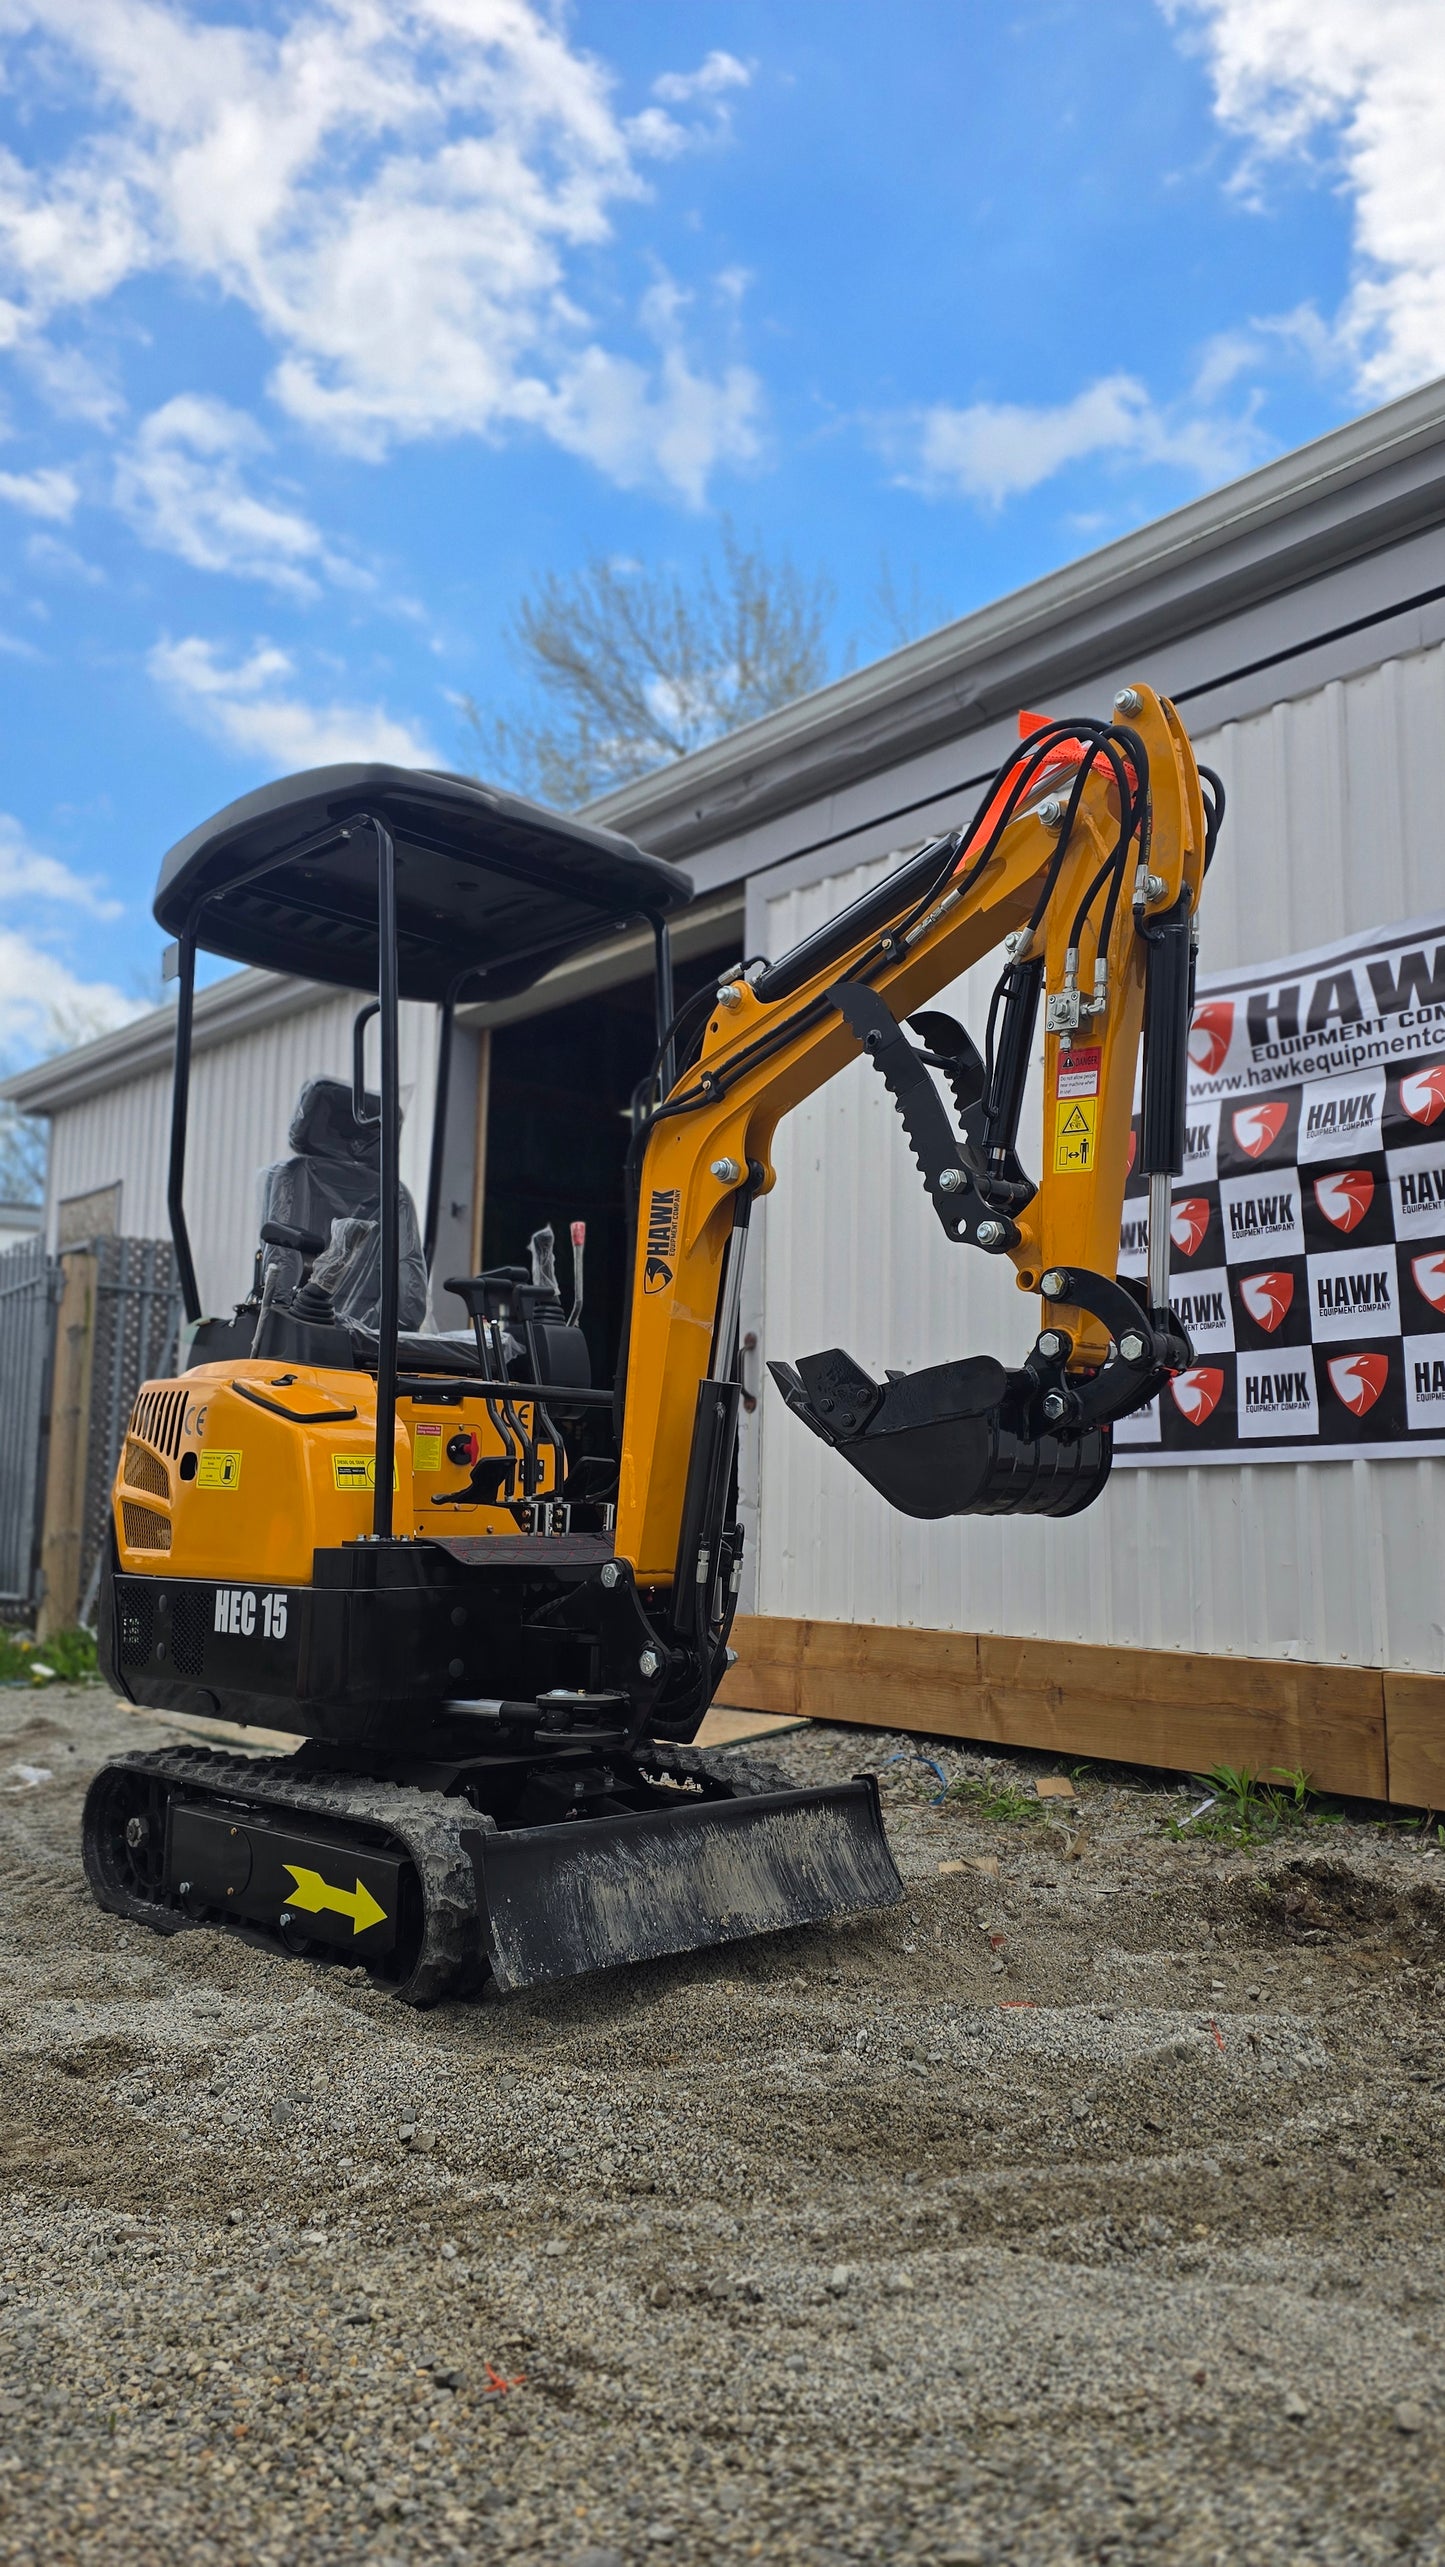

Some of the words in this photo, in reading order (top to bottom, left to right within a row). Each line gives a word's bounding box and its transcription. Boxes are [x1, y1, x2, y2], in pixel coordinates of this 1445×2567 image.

[1251, 1017, 1388, 1063] EQUIPMENT
[1307, 1093, 1376, 1131] HAWK
[1184, 1124, 1211, 1154] WK
[1306, 1125, 1341, 1139] EQUIPMENT
[1342, 1118, 1374, 1132] COMPANY
[673, 1189, 681, 1220] COMPANY
[1230, 1193, 1294, 1231] HAWK
[1402, 1201, 1442, 1214] EQUIPMENT
[647, 1189, 675, 1256] HAWK
[1120, 1220, 1148, 1249] WK
[1232, 1227, 1264, 1239] EQUIPMENT
[1265, 1222, 1295, 1234] COMPANY
[669, 1221, 678, 1257] EQUIPMENT
[1317, 1271, 1390, 1308] HAWK
[1319, 1305, 1357, 1317] EQUIPMENT
[1358, 1302, 1391, 1313] COMPANY
[1200, 1320, 1227, 1331] COMPANY
[1246, 1372, 1310, 1404] HAWK
[1246, 1403, 1279, 1413] EQUIPMENT
[1281, 1401, 1311, 1411] COMPANY
[214, 1589, 256, 1636] HEC
[262, 1593, 288, 1639] 15
